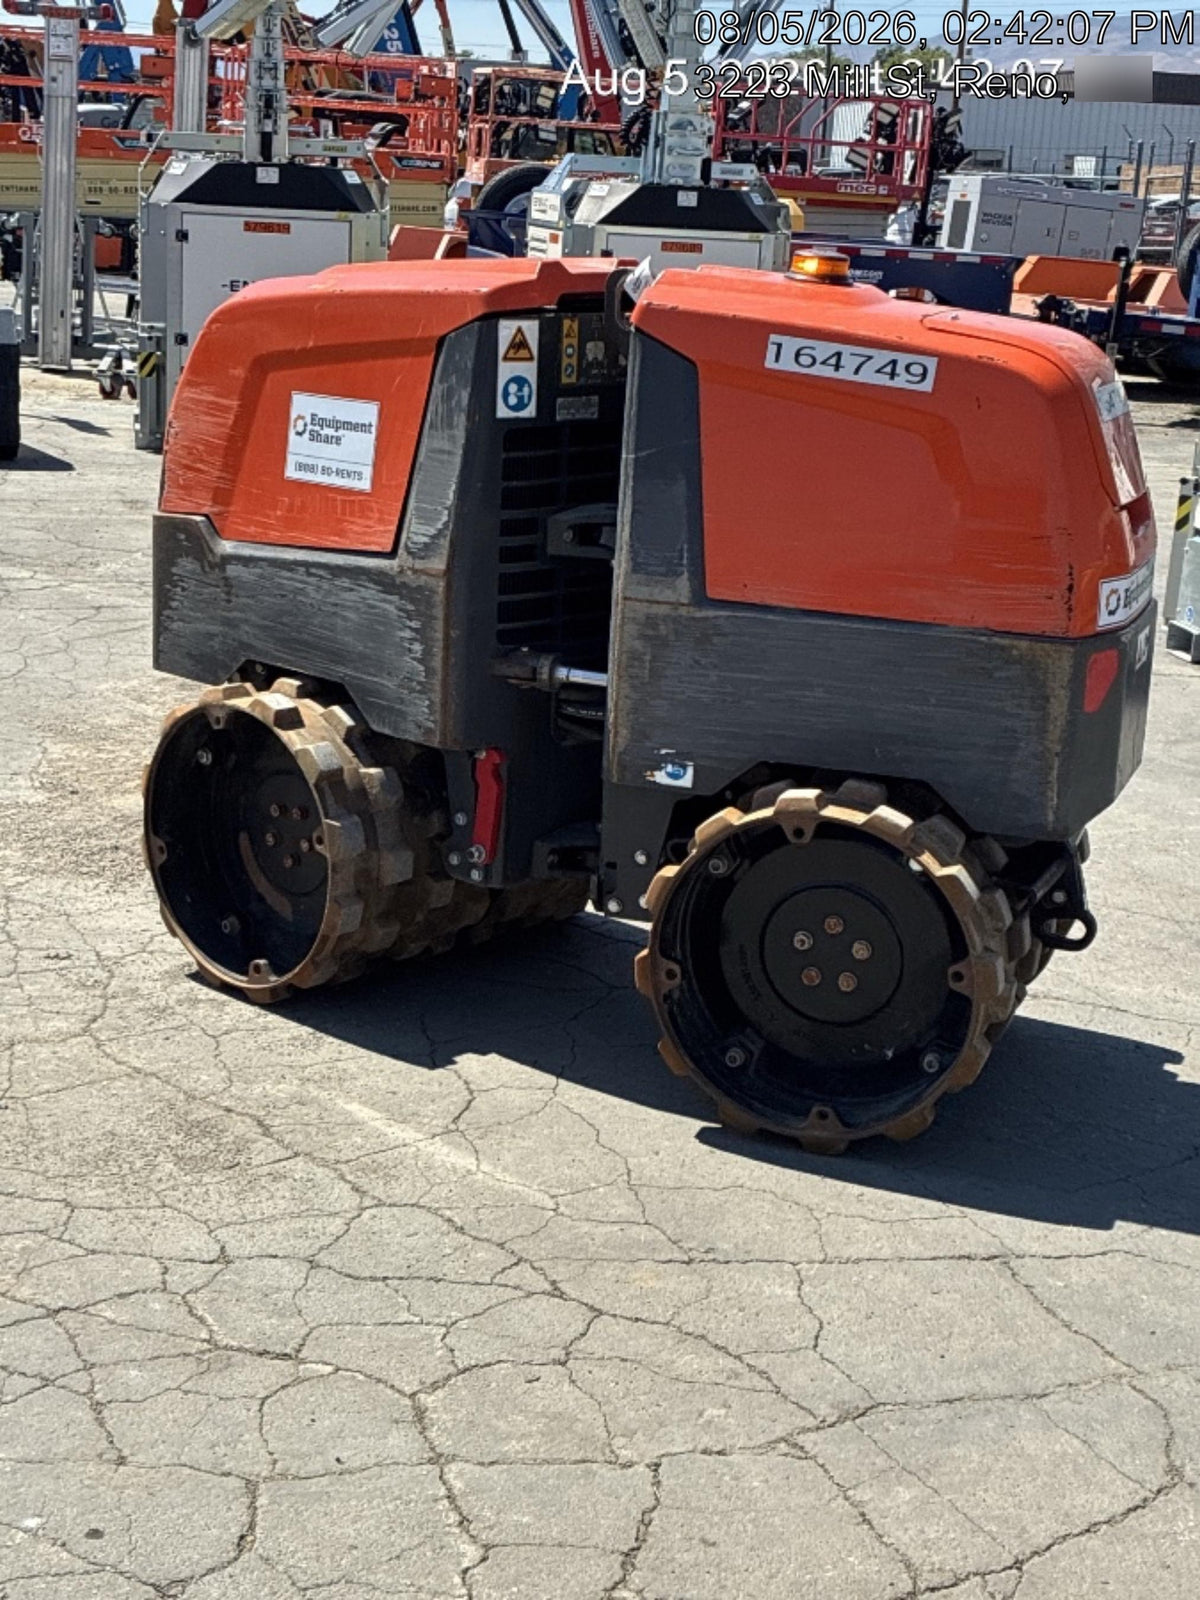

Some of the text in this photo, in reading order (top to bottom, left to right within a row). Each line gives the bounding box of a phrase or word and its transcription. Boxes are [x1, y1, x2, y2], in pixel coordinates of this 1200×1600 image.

[769, 341, 930, 386] 164749
[309, 412, 374, 435] Equipment
[308, 429, 343, 446] Share
